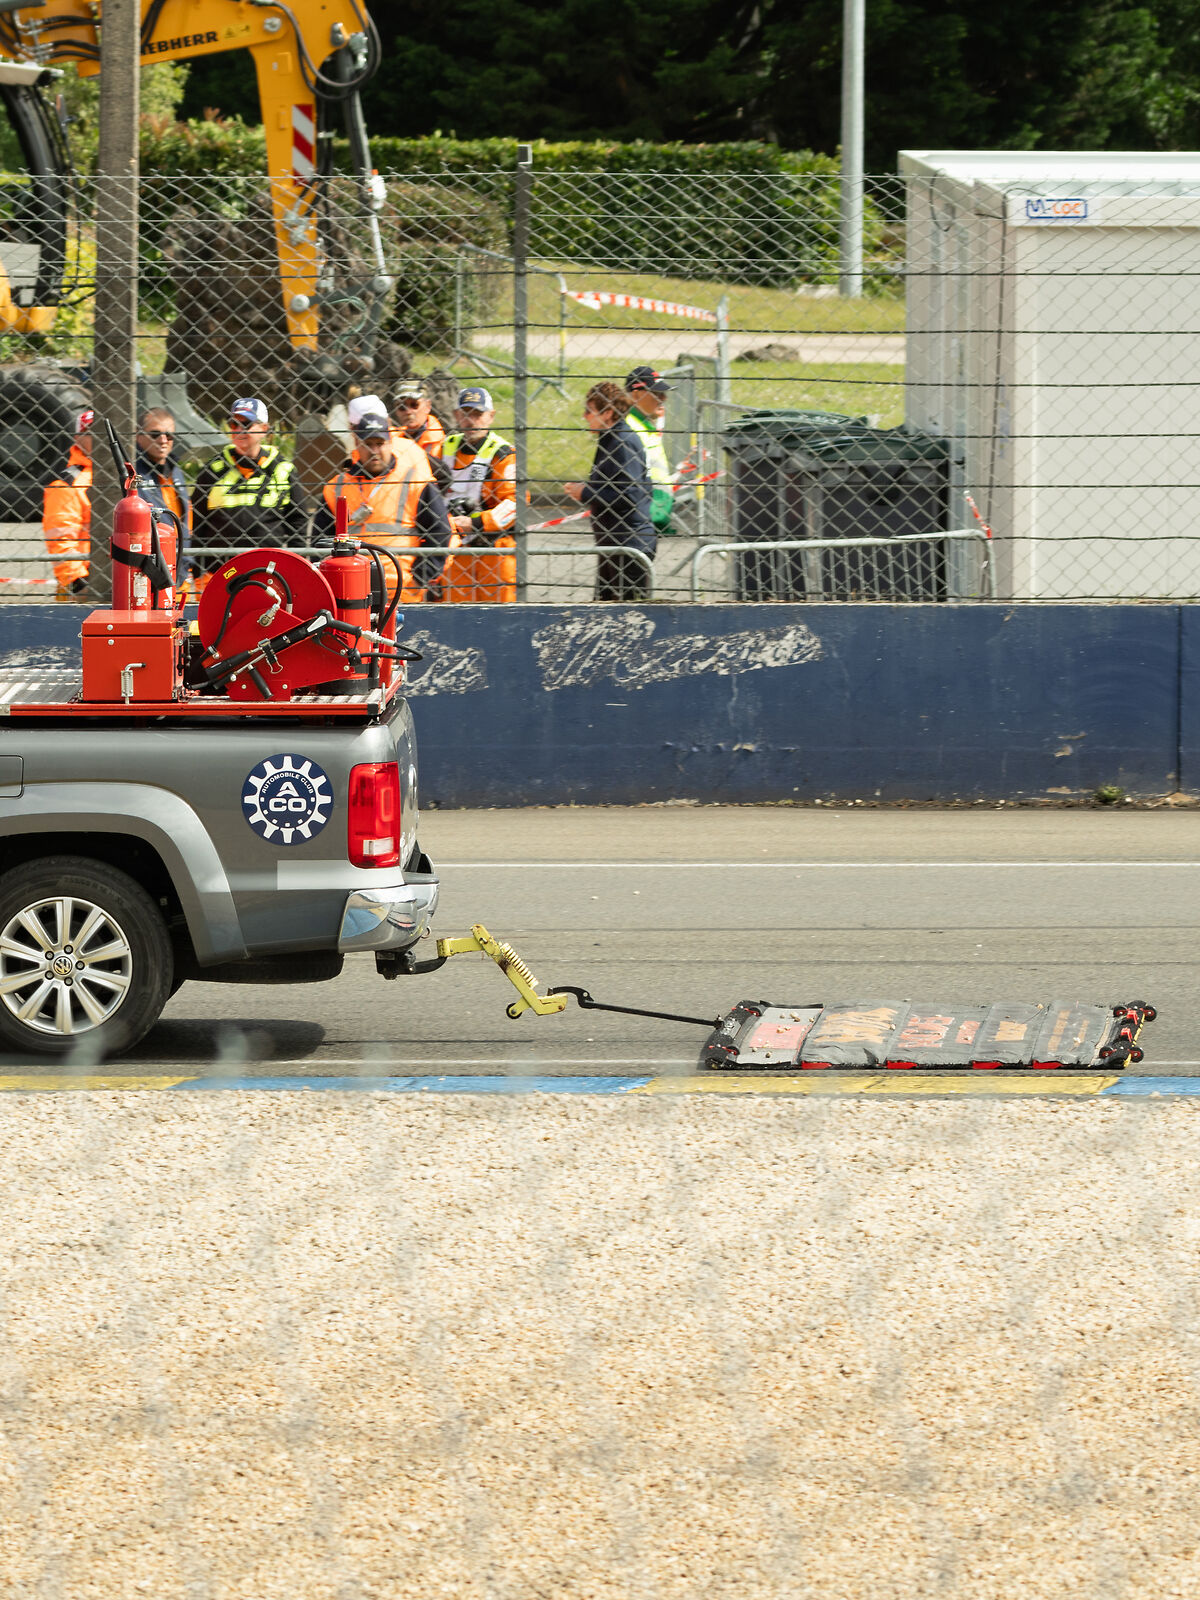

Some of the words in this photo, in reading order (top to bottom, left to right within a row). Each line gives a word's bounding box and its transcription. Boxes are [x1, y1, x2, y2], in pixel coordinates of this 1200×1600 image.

[140, 30, 219, 55] IEBHERR
[261, 772, 301, 794] AUTOMOBILE
[300, 777, 314, 794] CLUB
